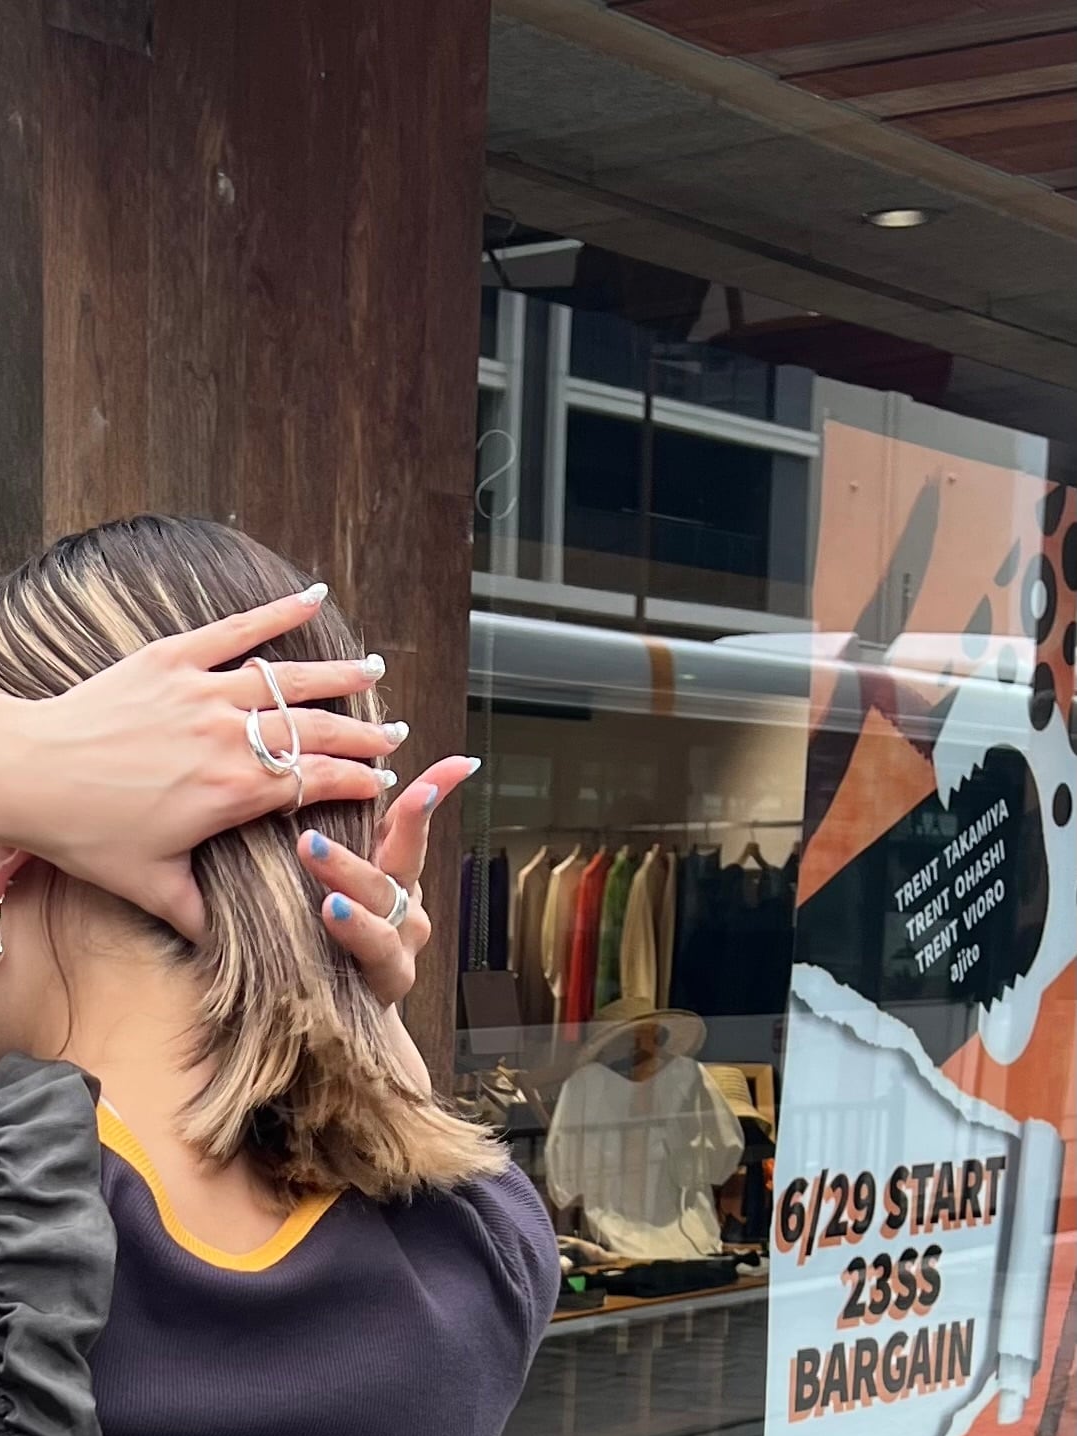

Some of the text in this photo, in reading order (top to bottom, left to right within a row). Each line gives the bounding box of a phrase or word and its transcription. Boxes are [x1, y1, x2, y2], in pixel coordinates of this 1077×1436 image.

[894, 798, 1010, 913] TRENT TAKAMIYA
[905, 839, 1007, 942] TRENT OHASHI
[914, 878, 1005, 975] TRENT VIORO
[949, 943, 981, 984] ajito
[774, 1155, 1007, 1266] 6/29 START
[835, 1243, 943, 1330] 23SS
[787, 1317, 976, 1424] BARGAIN
